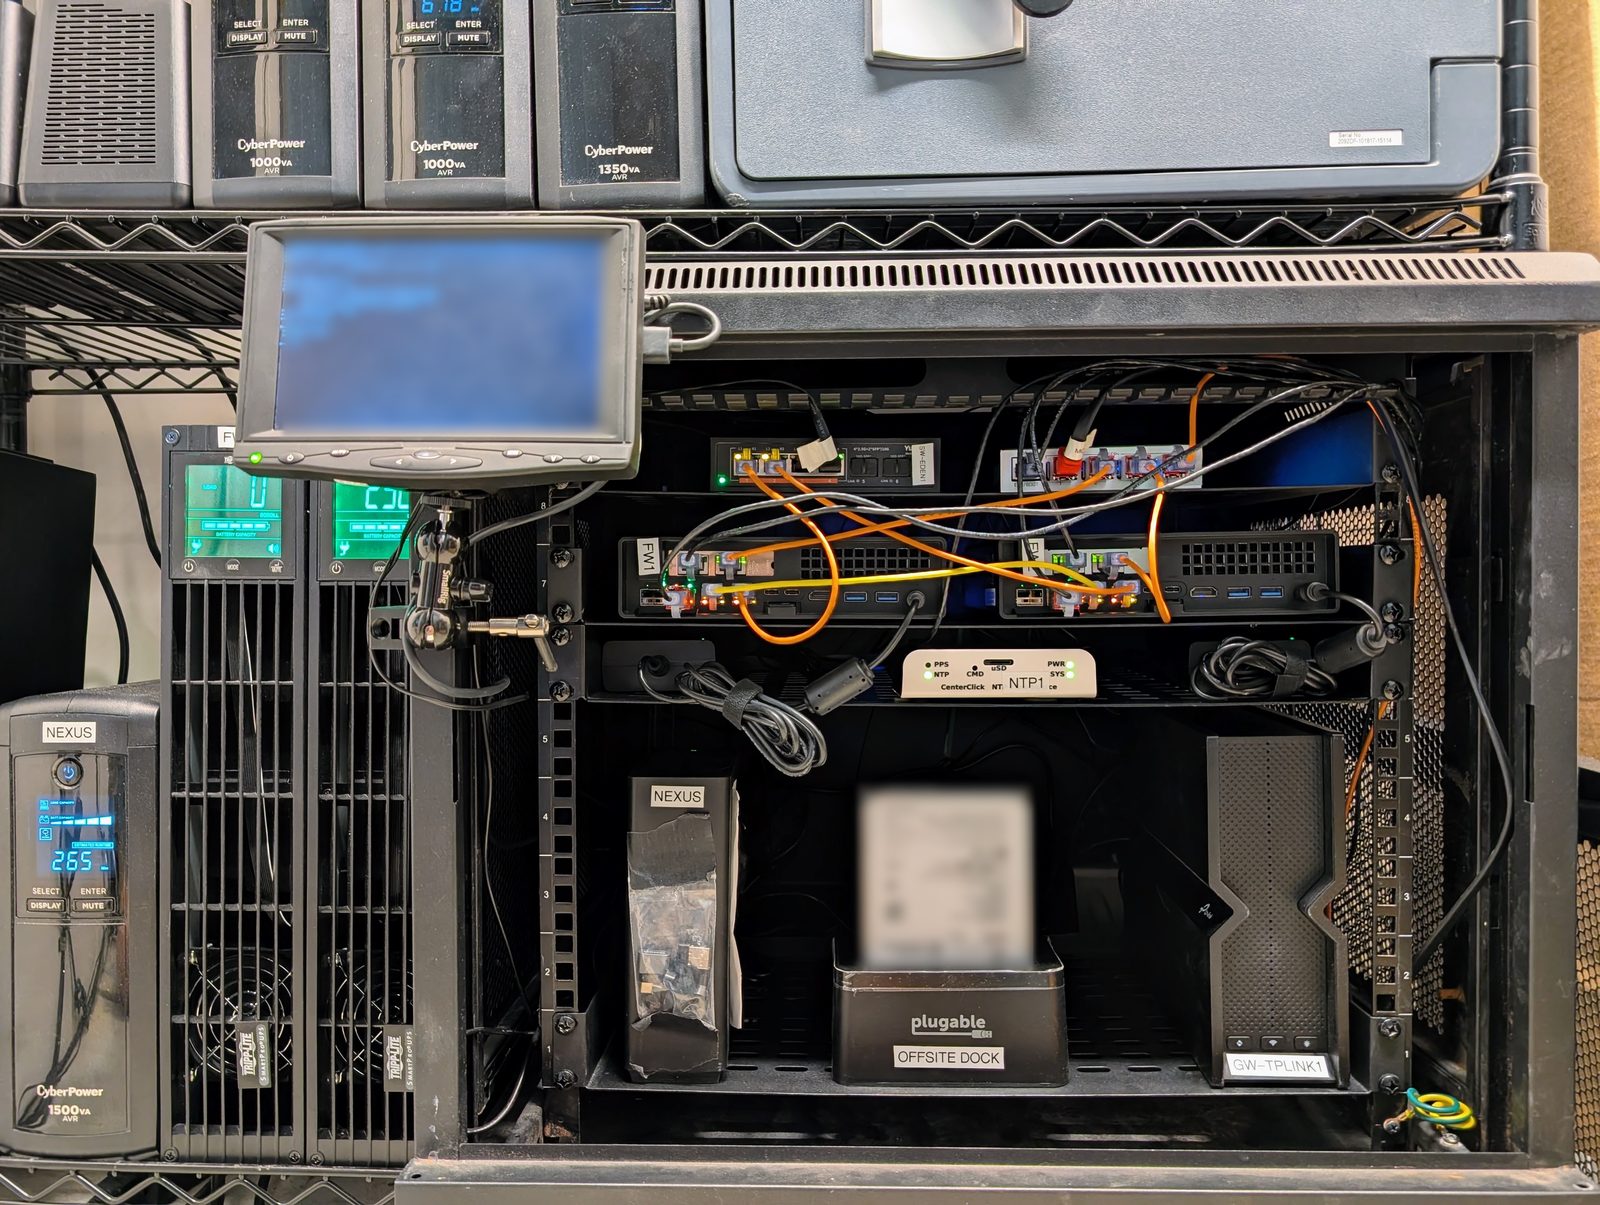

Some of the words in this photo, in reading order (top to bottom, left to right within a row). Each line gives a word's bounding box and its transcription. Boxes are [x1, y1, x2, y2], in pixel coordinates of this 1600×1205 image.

[233, 20, 262, 29] SELECT
[282, 19, 309, 27] ENTER
[406, 21, 435, 29] SELECT
[455, 20, 482, 28] ENTER
[231, 33, 263, 42] DISPLAY
[284, 32, 306, 40] MUTE
[404, 34, 436, 43] DISPLAY
[457, 34, 480, 42] MUTE
[237, 138, 305, 152] CyberPower
[410, 140, 479, 154] CyberPower
[584, 144, 654, 158] CyberPower
[541, 501, 546, 510] 8
[642, 543, 655, 570] FW1
[541, 580, 547, 588] 7
[1009, 677, 1044, 689] NTP1
[46, 727, 92, 739] NEXUS
[542, 735, 548, 743] 5
[1404, 735, 1411, 743] 5
[654, 790, 701, 802] NEXUS
[1404, 814, 1410, 822] 4
[52, 851, 92, 871] 265
[32, 887, 60, 895] SELECT
[80, 887, 107, 895] ENTER
[543, 891, 549, 899] 3
[545, 967, 551, 976] 2
[1403, 972, 1410, 980] 2
[911, 1014, 986, 1033] plugable
[898, 1051, 956, 1063] OFFSITE
[960, 1052, 999, 1064] DOCK
[1404, 1050, 1409, 1058] 1
[1233, 1058, 1322, 1072] GW-TPLINK1
[36, 1084, 103, 1098] CyberPower
